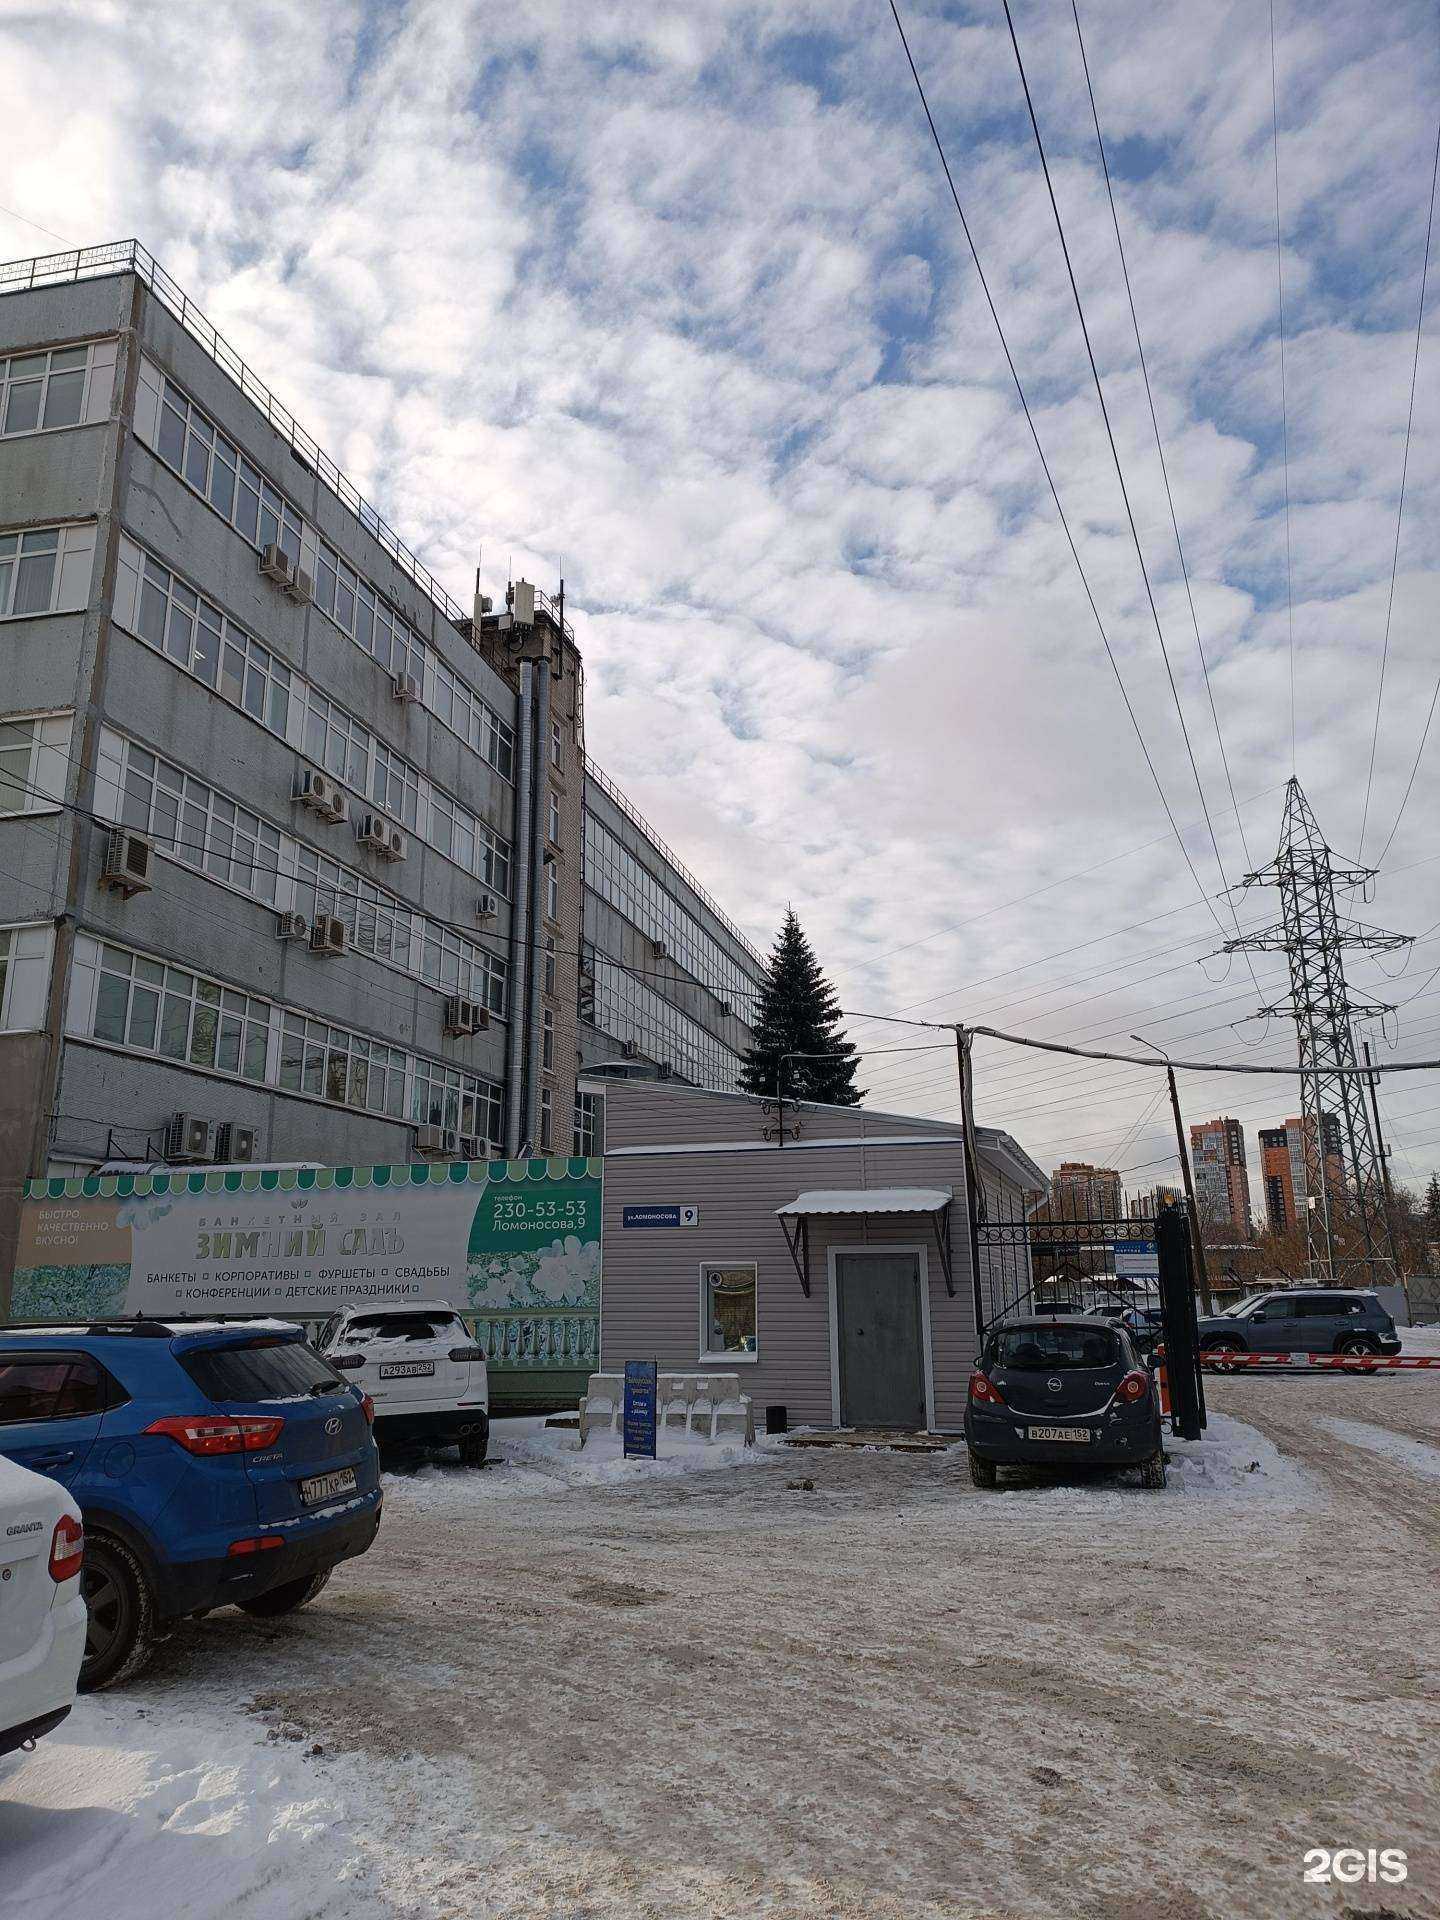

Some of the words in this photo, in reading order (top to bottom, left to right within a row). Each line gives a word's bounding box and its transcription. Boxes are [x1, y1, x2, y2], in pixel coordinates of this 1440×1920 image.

[359, 1211, 401, 1222] ЗАЛ
[493, 1200, 586, 1218] 230-53-53
[684, 1209, 694, 1222] 9
[194, 1223, 327, 1260] ЗИМНИЙ
[146, 1271, 196, 1283] БАНКЕТЫ
[215, 1269, 299, 1282] КОРПОРАТИВЫ
[318, 1268, 375, 1279] ФУРШЕТЫ
[395, 1266, 450, 1278] СВАДЬБЫ
[185, 1287, 271, 1299] КОНФЕРЕНЦИИ
[285, 1285, 337, 1298] ДЕТСКИЕ
[340, 1284, 410, 1296] ПРАЗДНИКИ
[1072, 1429, 1087, 1438] 152
[6, 1521, 44, 1536] GRANTA
